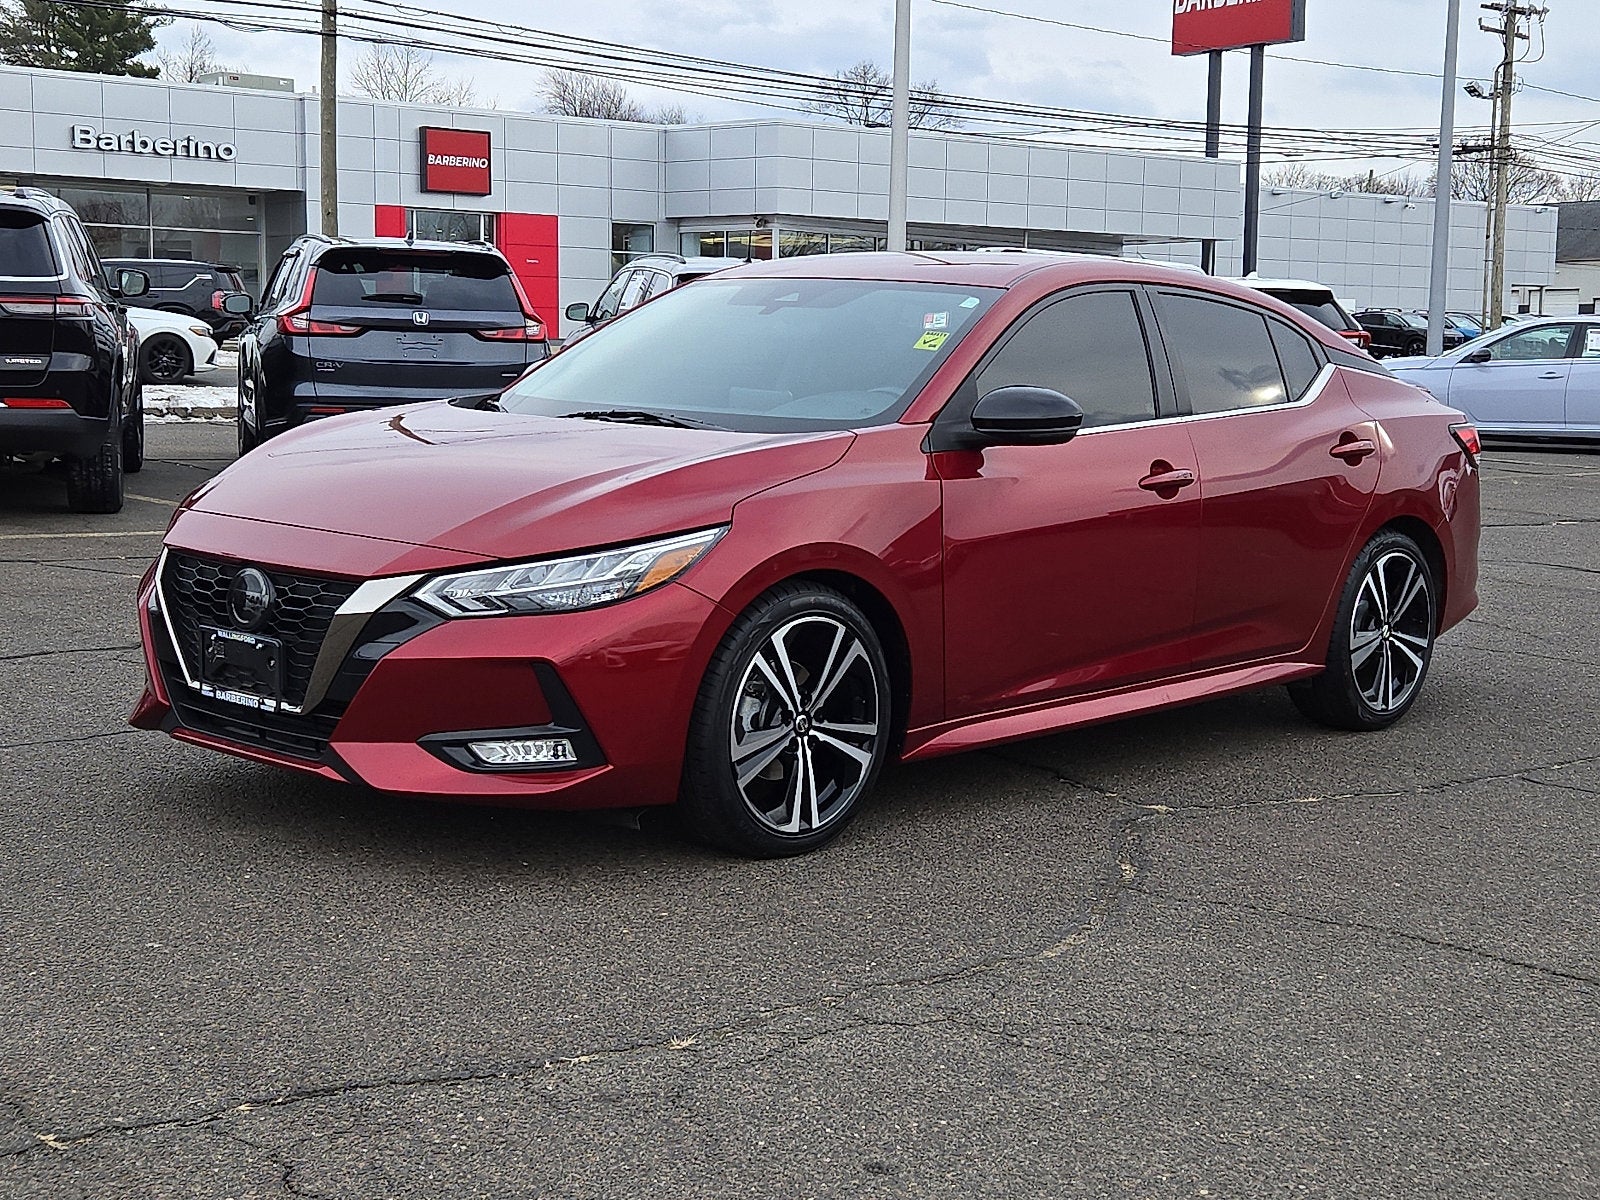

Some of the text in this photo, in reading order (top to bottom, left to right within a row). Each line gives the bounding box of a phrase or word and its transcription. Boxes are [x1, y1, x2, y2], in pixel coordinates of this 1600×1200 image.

[72, 124, 238, 160] Barberino
[427, 153, 489, 169] BARBERINO
[215, 689, 260, 708] BARBERINO
